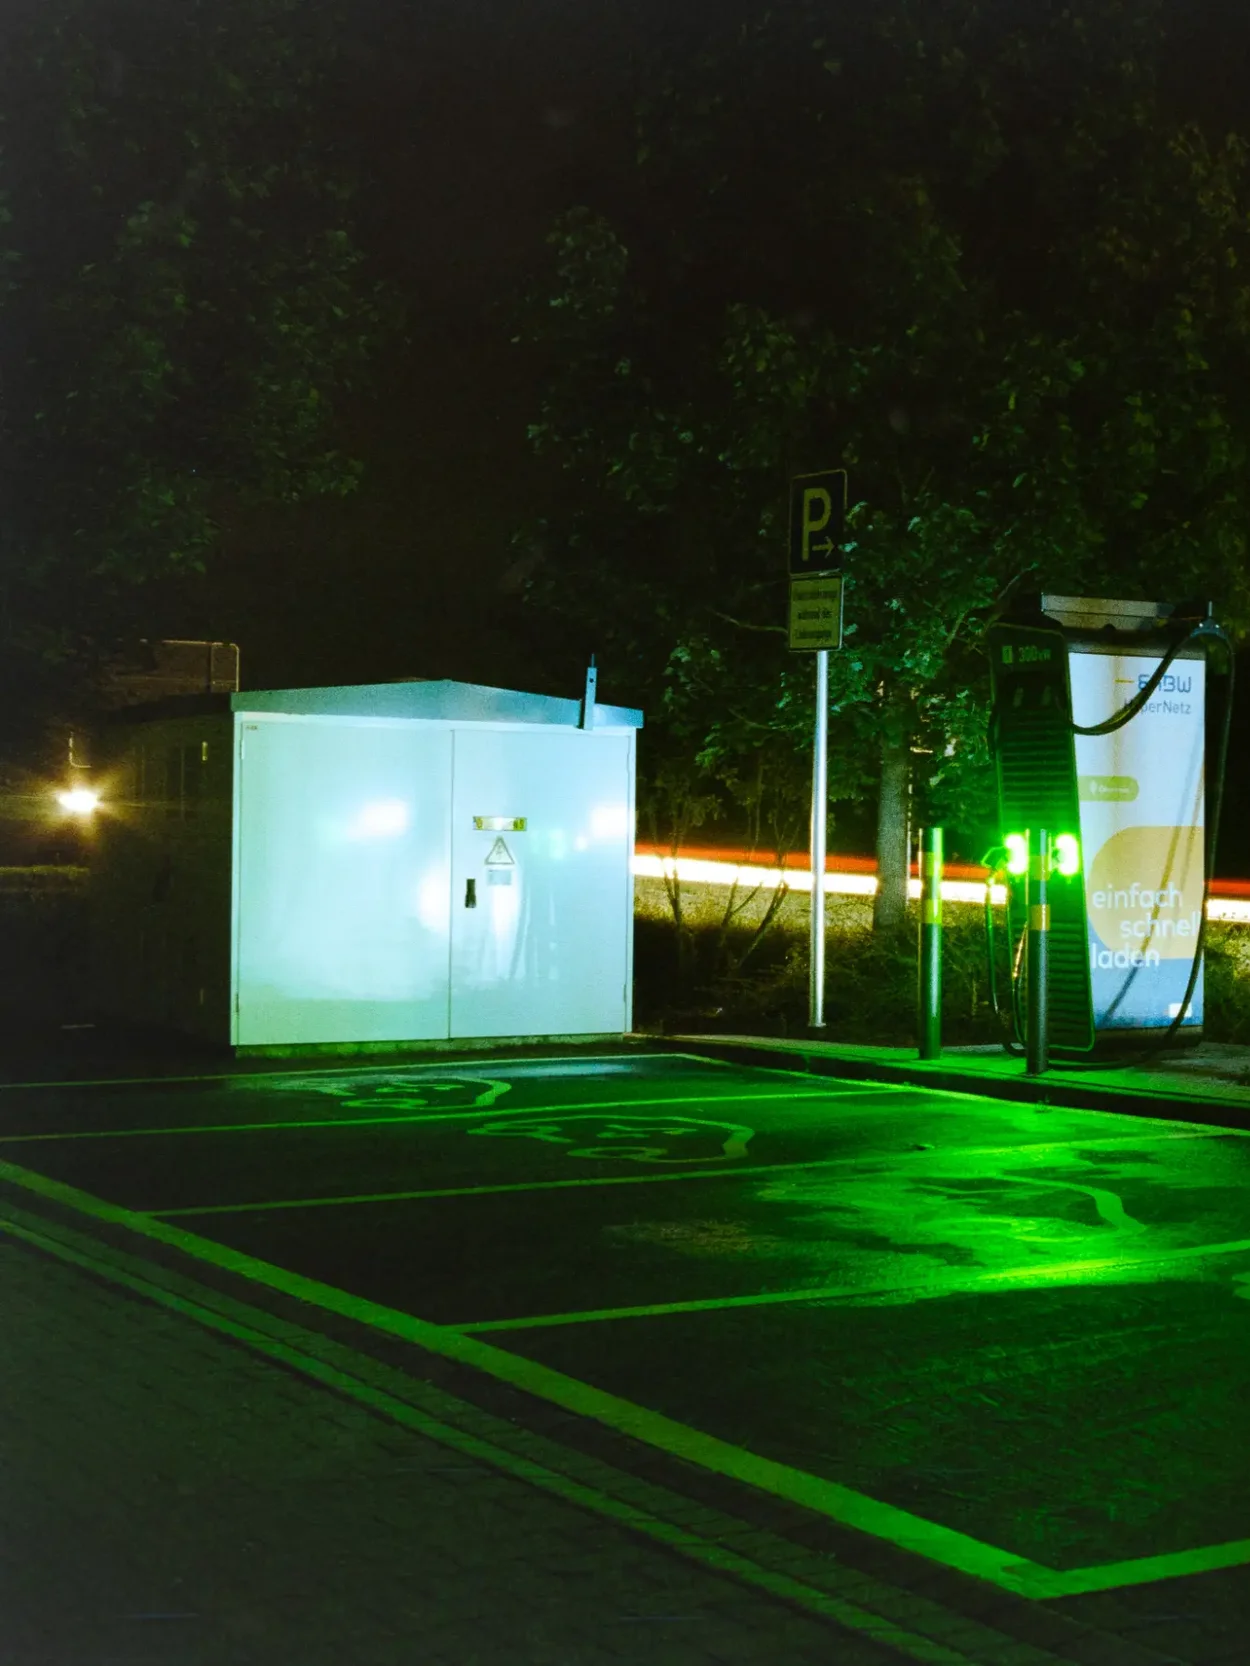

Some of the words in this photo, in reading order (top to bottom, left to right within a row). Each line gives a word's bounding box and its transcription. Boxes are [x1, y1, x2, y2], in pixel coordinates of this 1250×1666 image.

[802, 488, 831, 561] P
[1124, 697, 1192, 715] perNetz
[1091, 882, 1182, 909] einfach
[1091, 942, 1160, 970] laden
